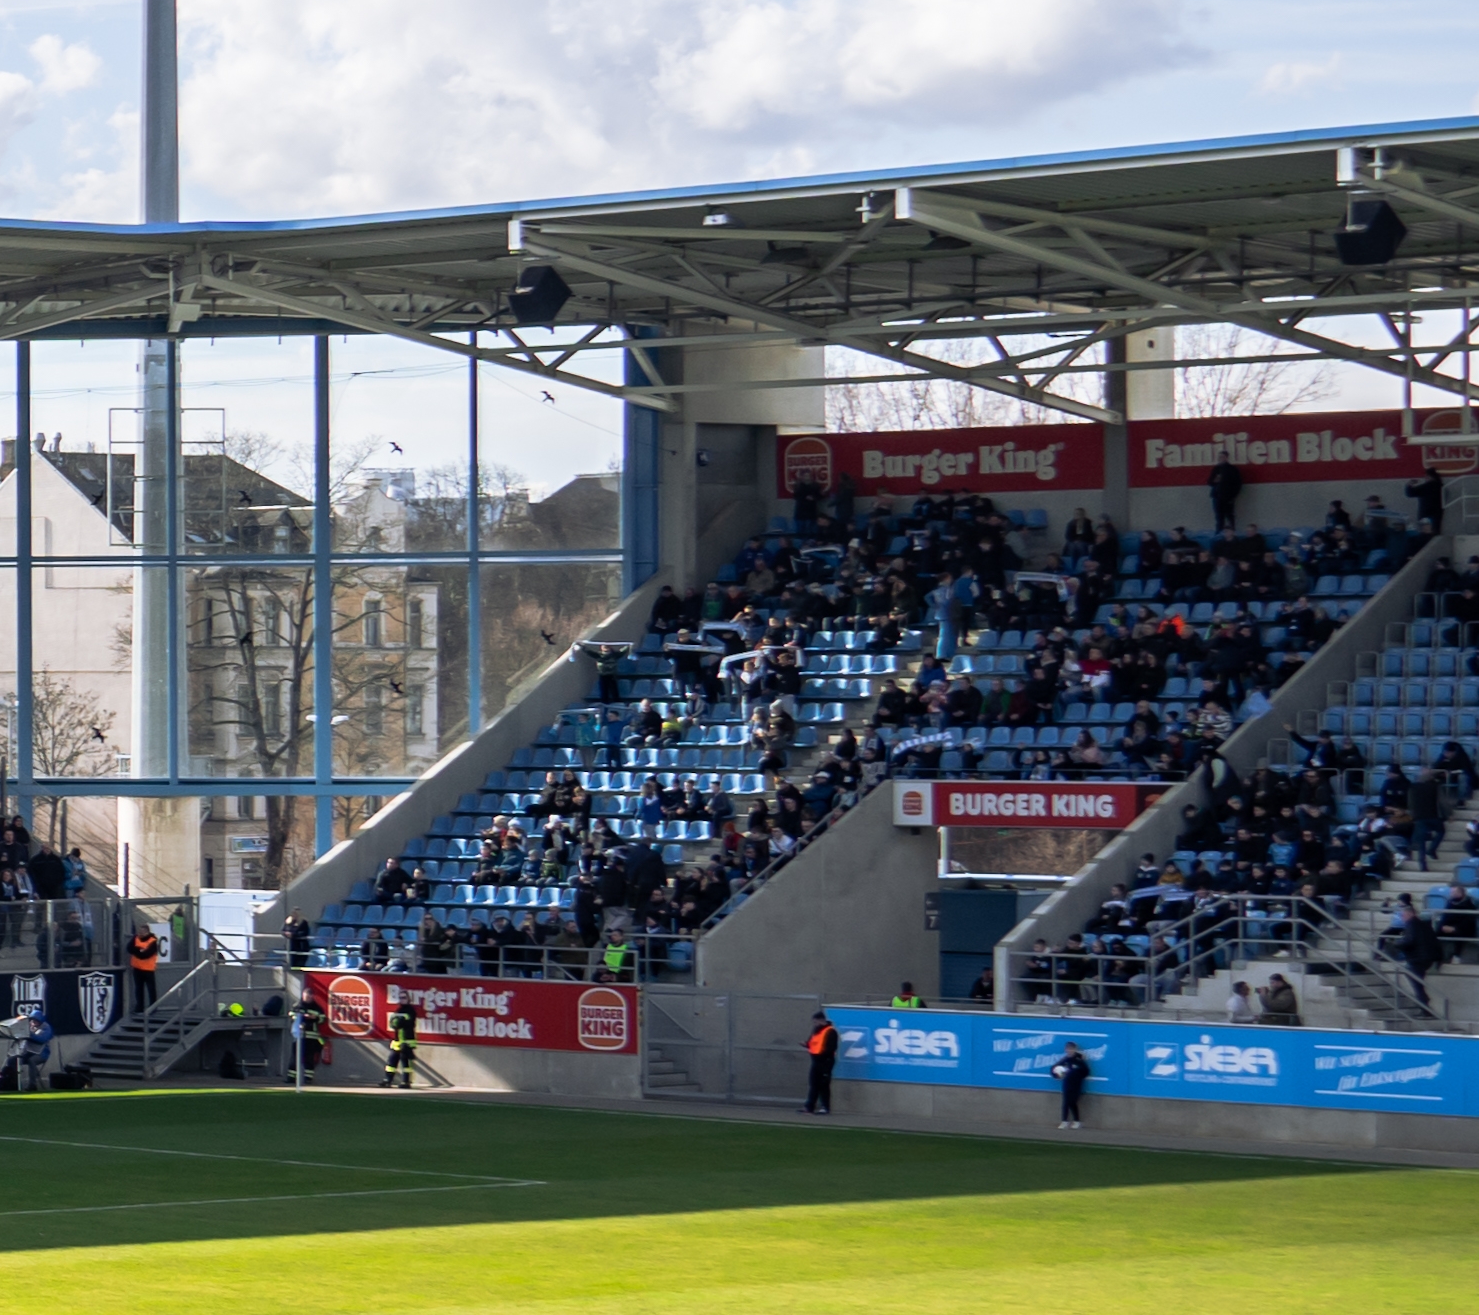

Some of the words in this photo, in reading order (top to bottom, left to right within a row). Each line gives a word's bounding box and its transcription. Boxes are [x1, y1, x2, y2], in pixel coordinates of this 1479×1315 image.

[1145, 433, 1292, 468] Familien
[1296, 429, 1398, 461] Block
[863, 448, 974, 485] Burger
[979, 441, 1055, 481] King
[949, 791, 1046, 817] BURGER
[1051, 793, 1114, 818] KING
[85, 976, 107, 986] FCK
[330, 993, 370, 1007] BURGER
[461, 988, 507, 1016] King
[330, 1007, 371, 1024] KING
[580, 1007, 624, 1021] BURGER
[474, 1016, 533, 1040] Block
[580, 1020, 624, 1037] KING
